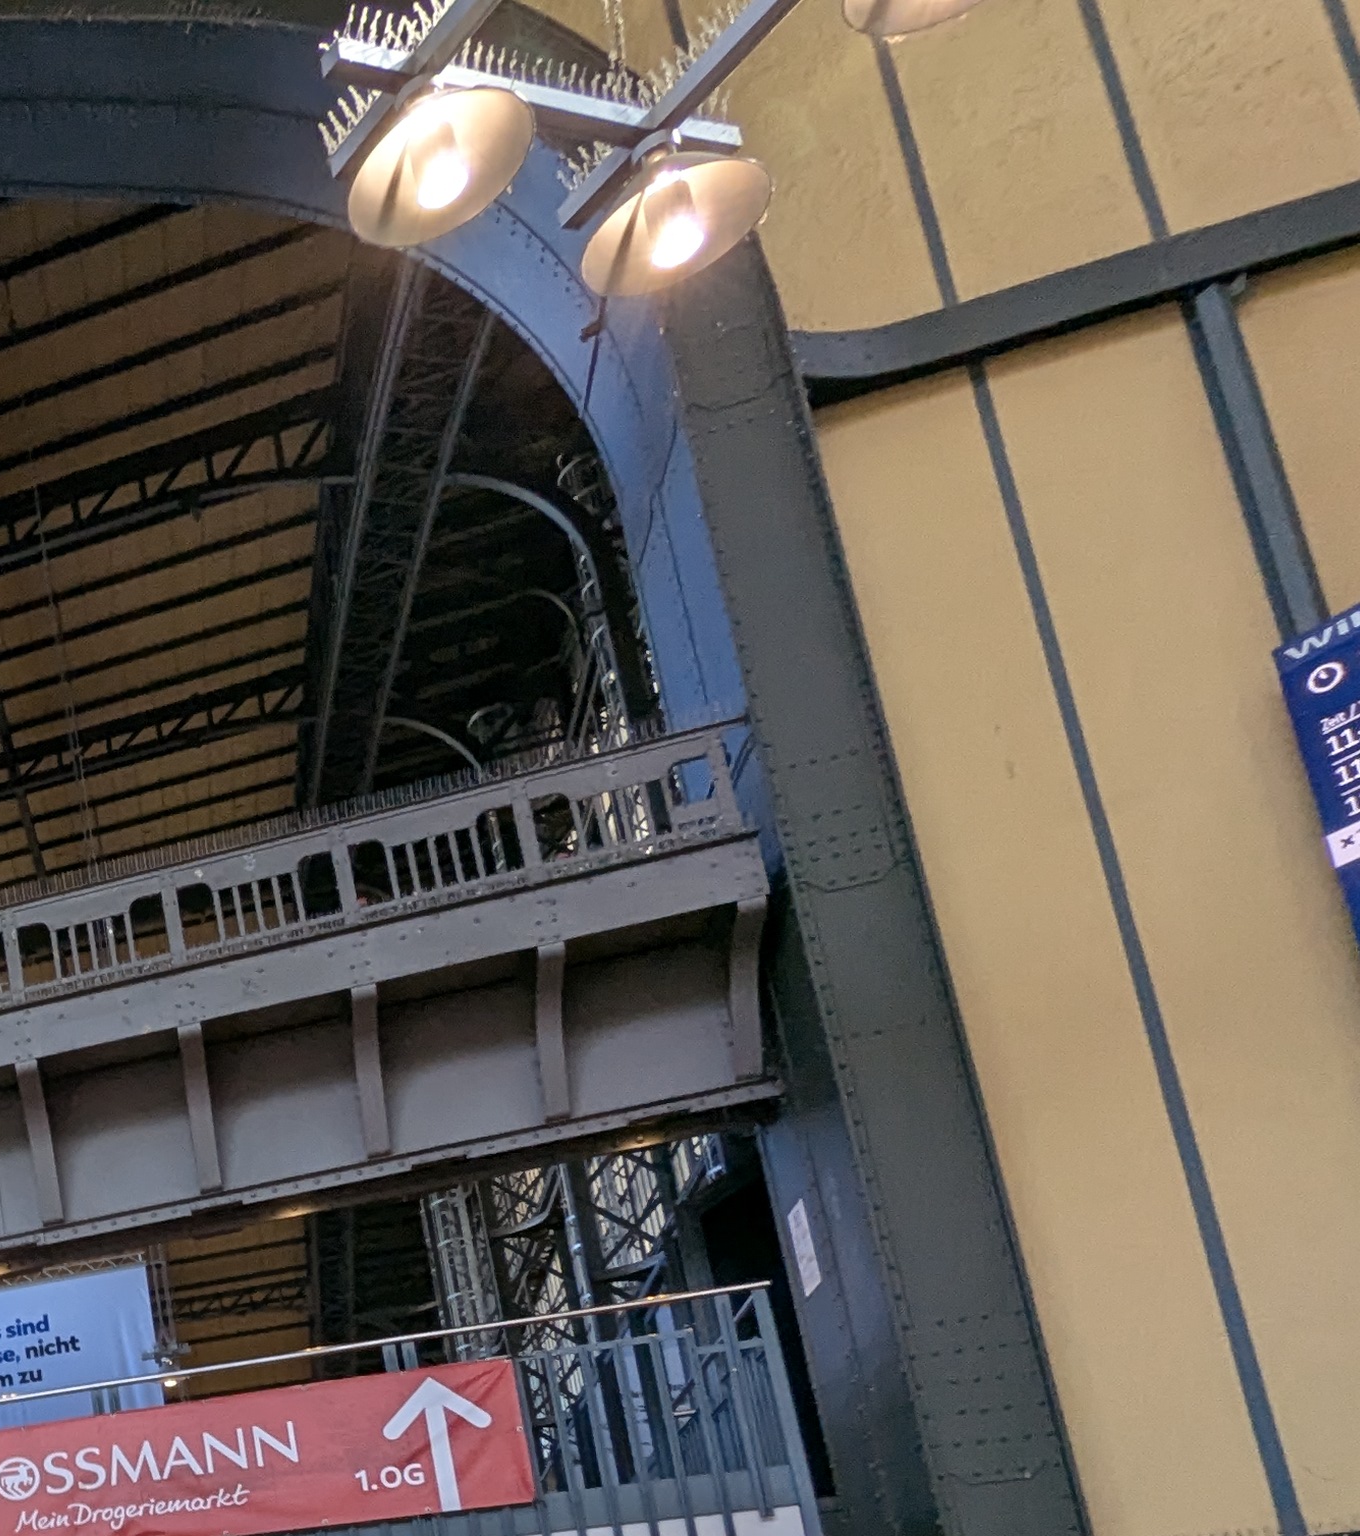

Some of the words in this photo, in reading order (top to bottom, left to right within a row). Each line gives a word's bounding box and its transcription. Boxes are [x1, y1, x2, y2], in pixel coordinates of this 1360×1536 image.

[5, 1314, 50, 1339] sind
[25, 1335, 81, 1360] nicht
[17, 1368, 43, 1384] zu
[14, 1508, 70, 1533] Mein
[67, 1483, 250, 1531] Drogeriemarkt
